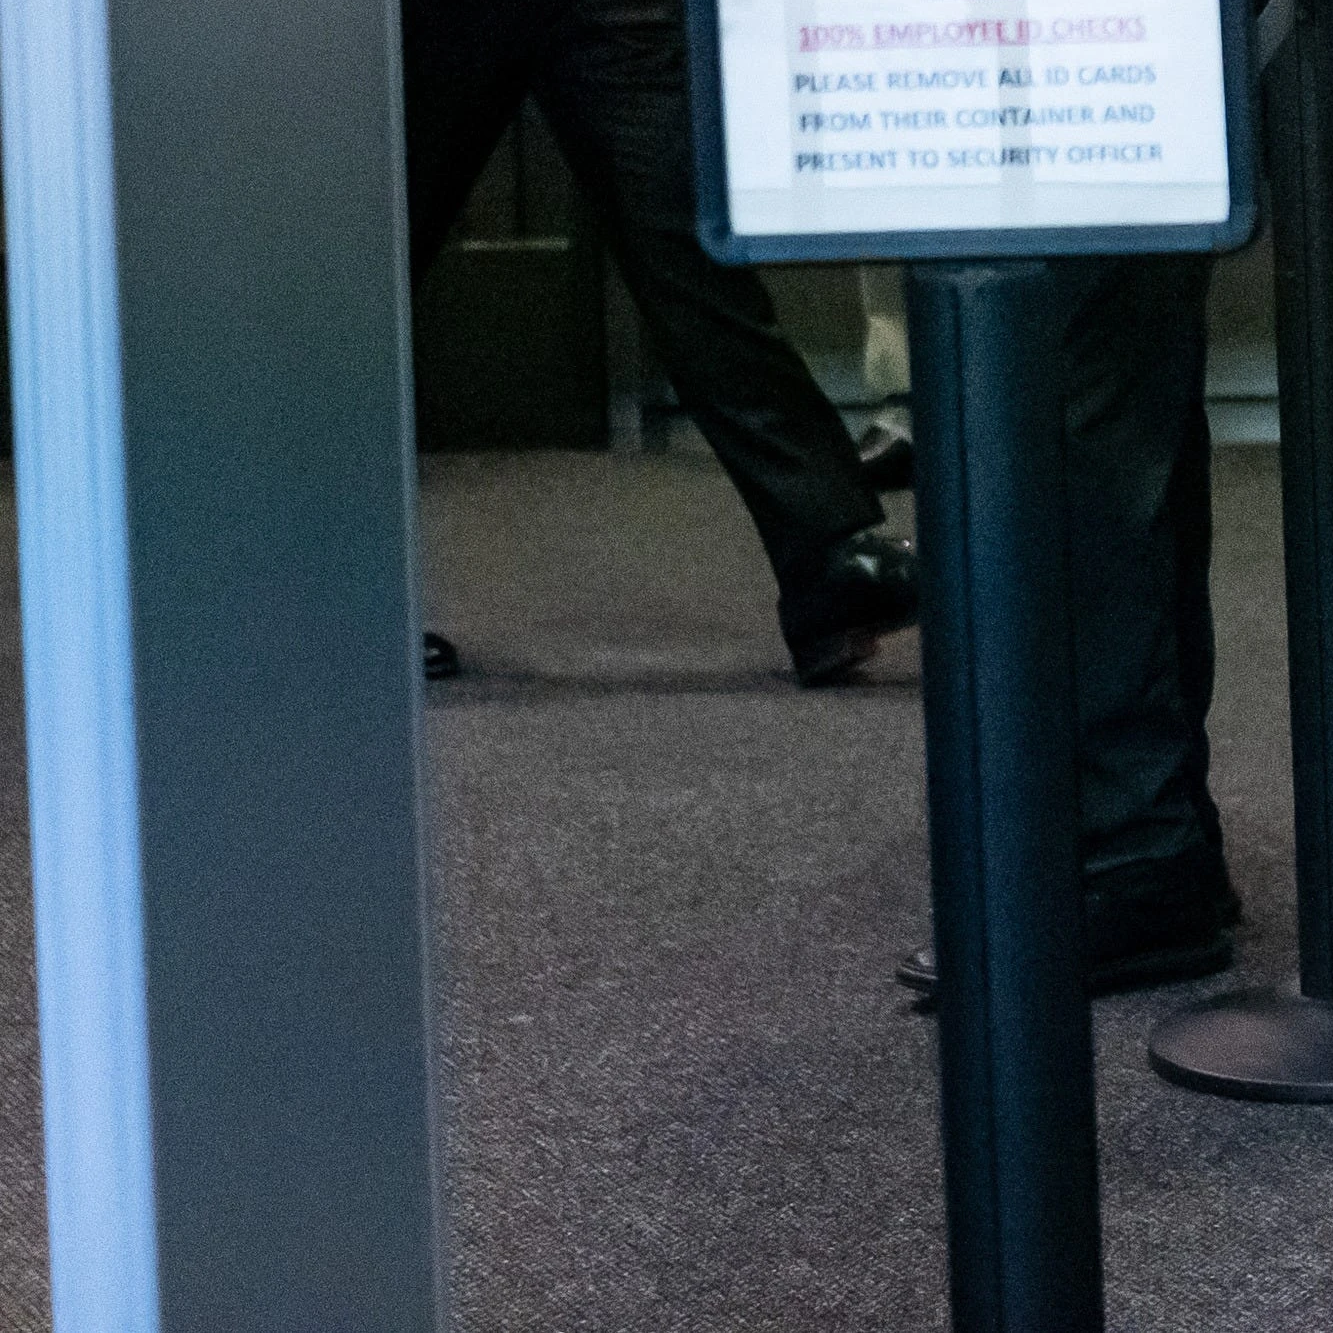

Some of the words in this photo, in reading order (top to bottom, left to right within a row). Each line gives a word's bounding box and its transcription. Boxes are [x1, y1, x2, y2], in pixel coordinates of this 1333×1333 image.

[800, 24, 864, 46] 100%
[872, 19, 1013, 46] EMPLOYEE
[1018, 18, 1042, 43] ID
[1051, 15, 1146, 41] CHECKS
[795, 72, 877, 93] PLEASE
[887, 70, 987, 89] REMOVE
[999, 68, 1034, 88] ALL
[1046, 67, 1069, 86] ID
[1078, 65, 1157, 86] CARDS
[801, 111, 871, 132] FROM
[880, 109, 945, 130] THEIR
[956, 105, 1094, 128] CONTAINER
[1103, 103, 1155, 124] AND
[795, 150, 897, 172] PRESENT
[908, 149, 940, 169] TO
[947, 145, 1059, 168] SECURITY
[1066, 142, 1163, 164] OFFICER
